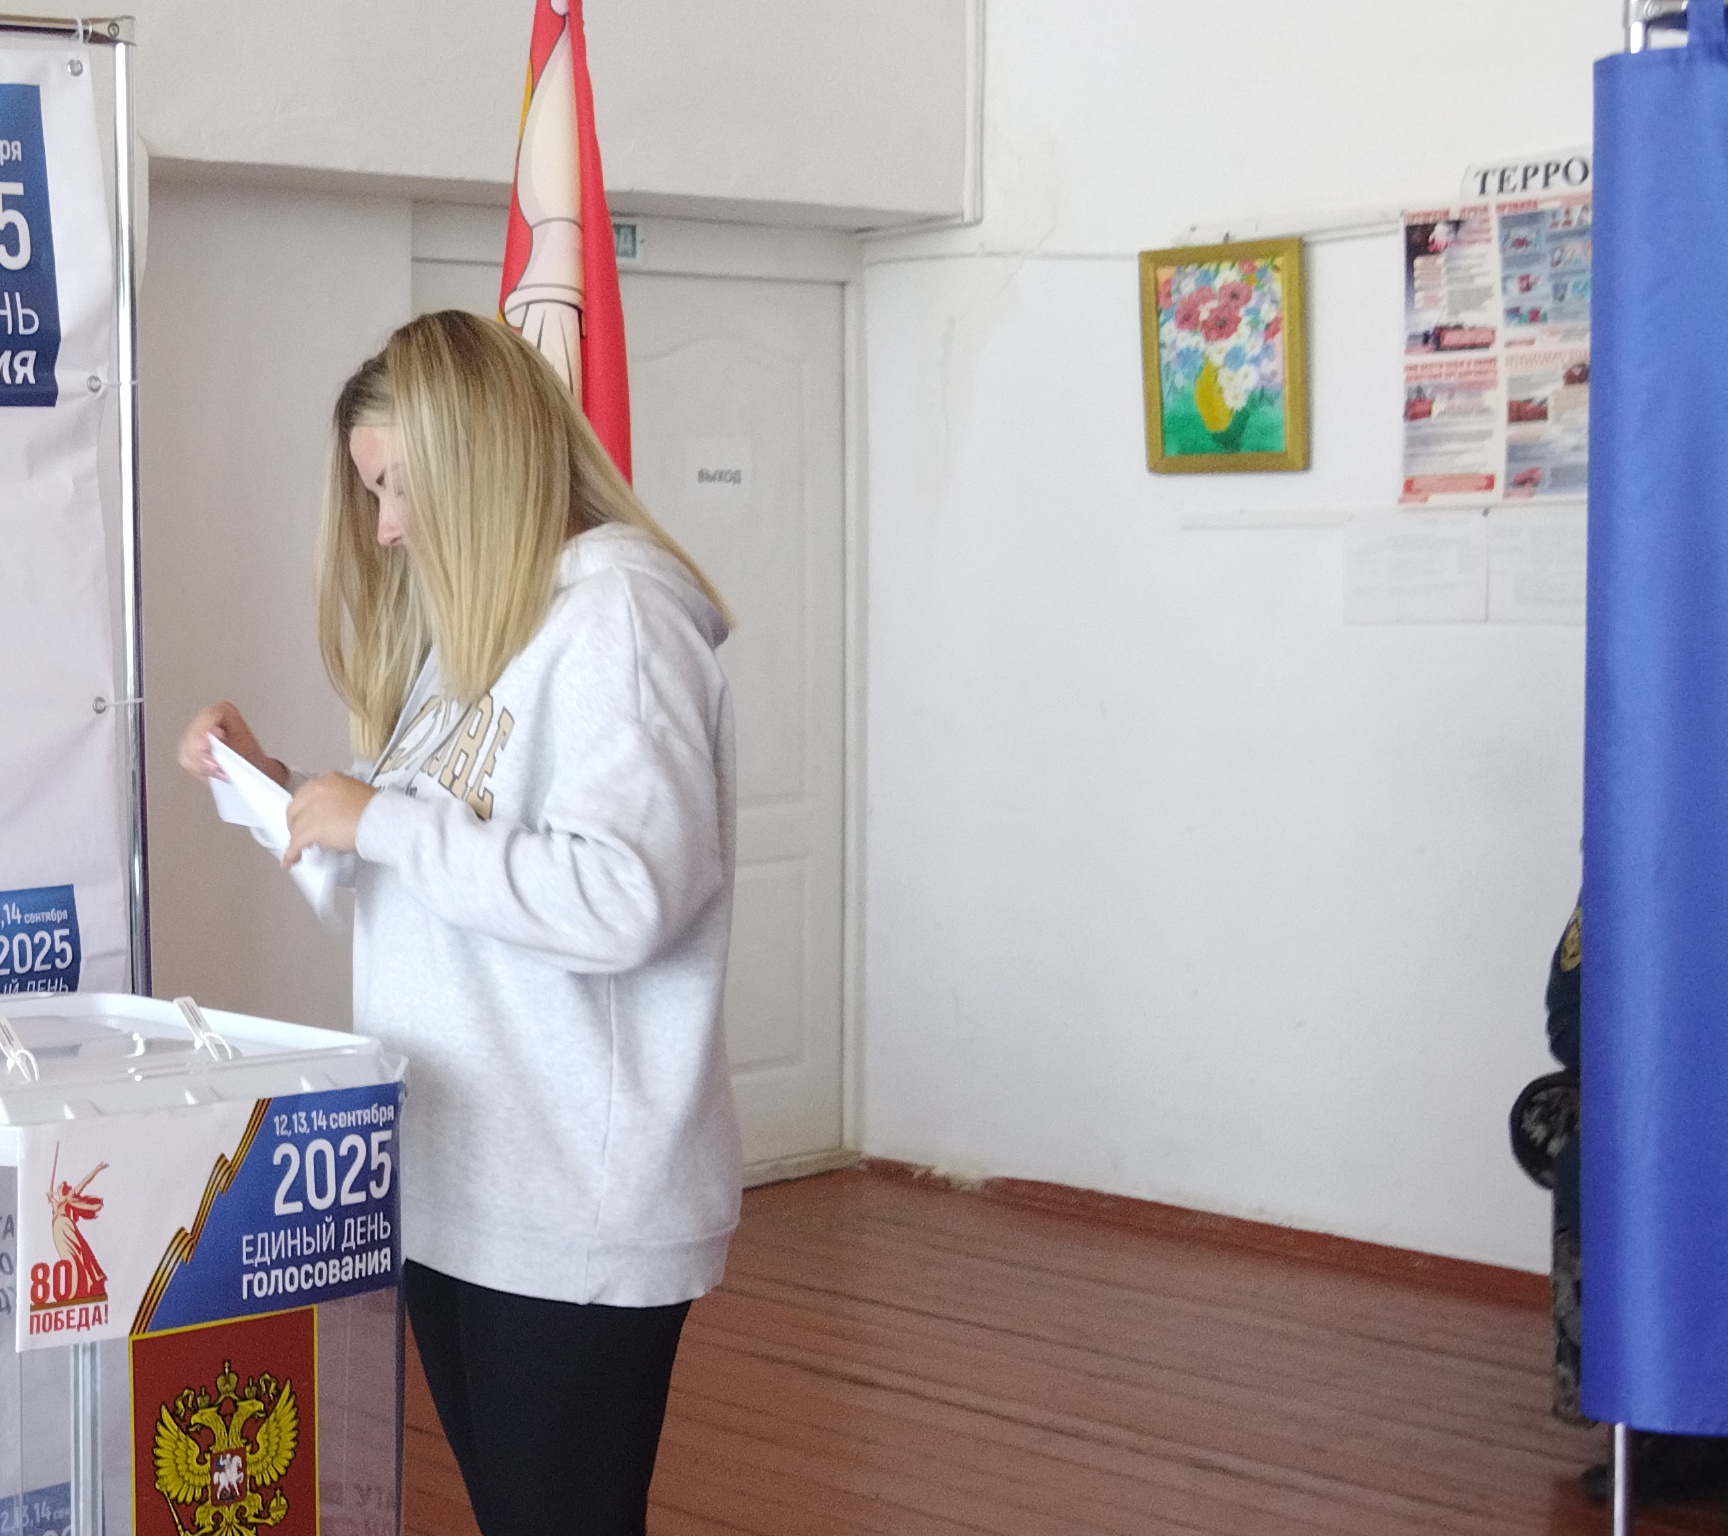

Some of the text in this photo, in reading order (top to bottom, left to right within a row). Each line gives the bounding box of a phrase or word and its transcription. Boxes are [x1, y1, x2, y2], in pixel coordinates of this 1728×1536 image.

[1474, 155, 1589, 197] ТЕРРО
[24, 907, 68, 924] сентября
[329, 1102, 395, 1130] сентября
[273, 1129, 393, 1216] 2025
[242, 1211, 391, 1267] ЕДИНЫЙ ДЕНЬ
[30, 1259, 73, 1305] 80
[242, 1246, 392, 1299] голосования
[29, 1303, 109, 1335] ПОБЕДА!
